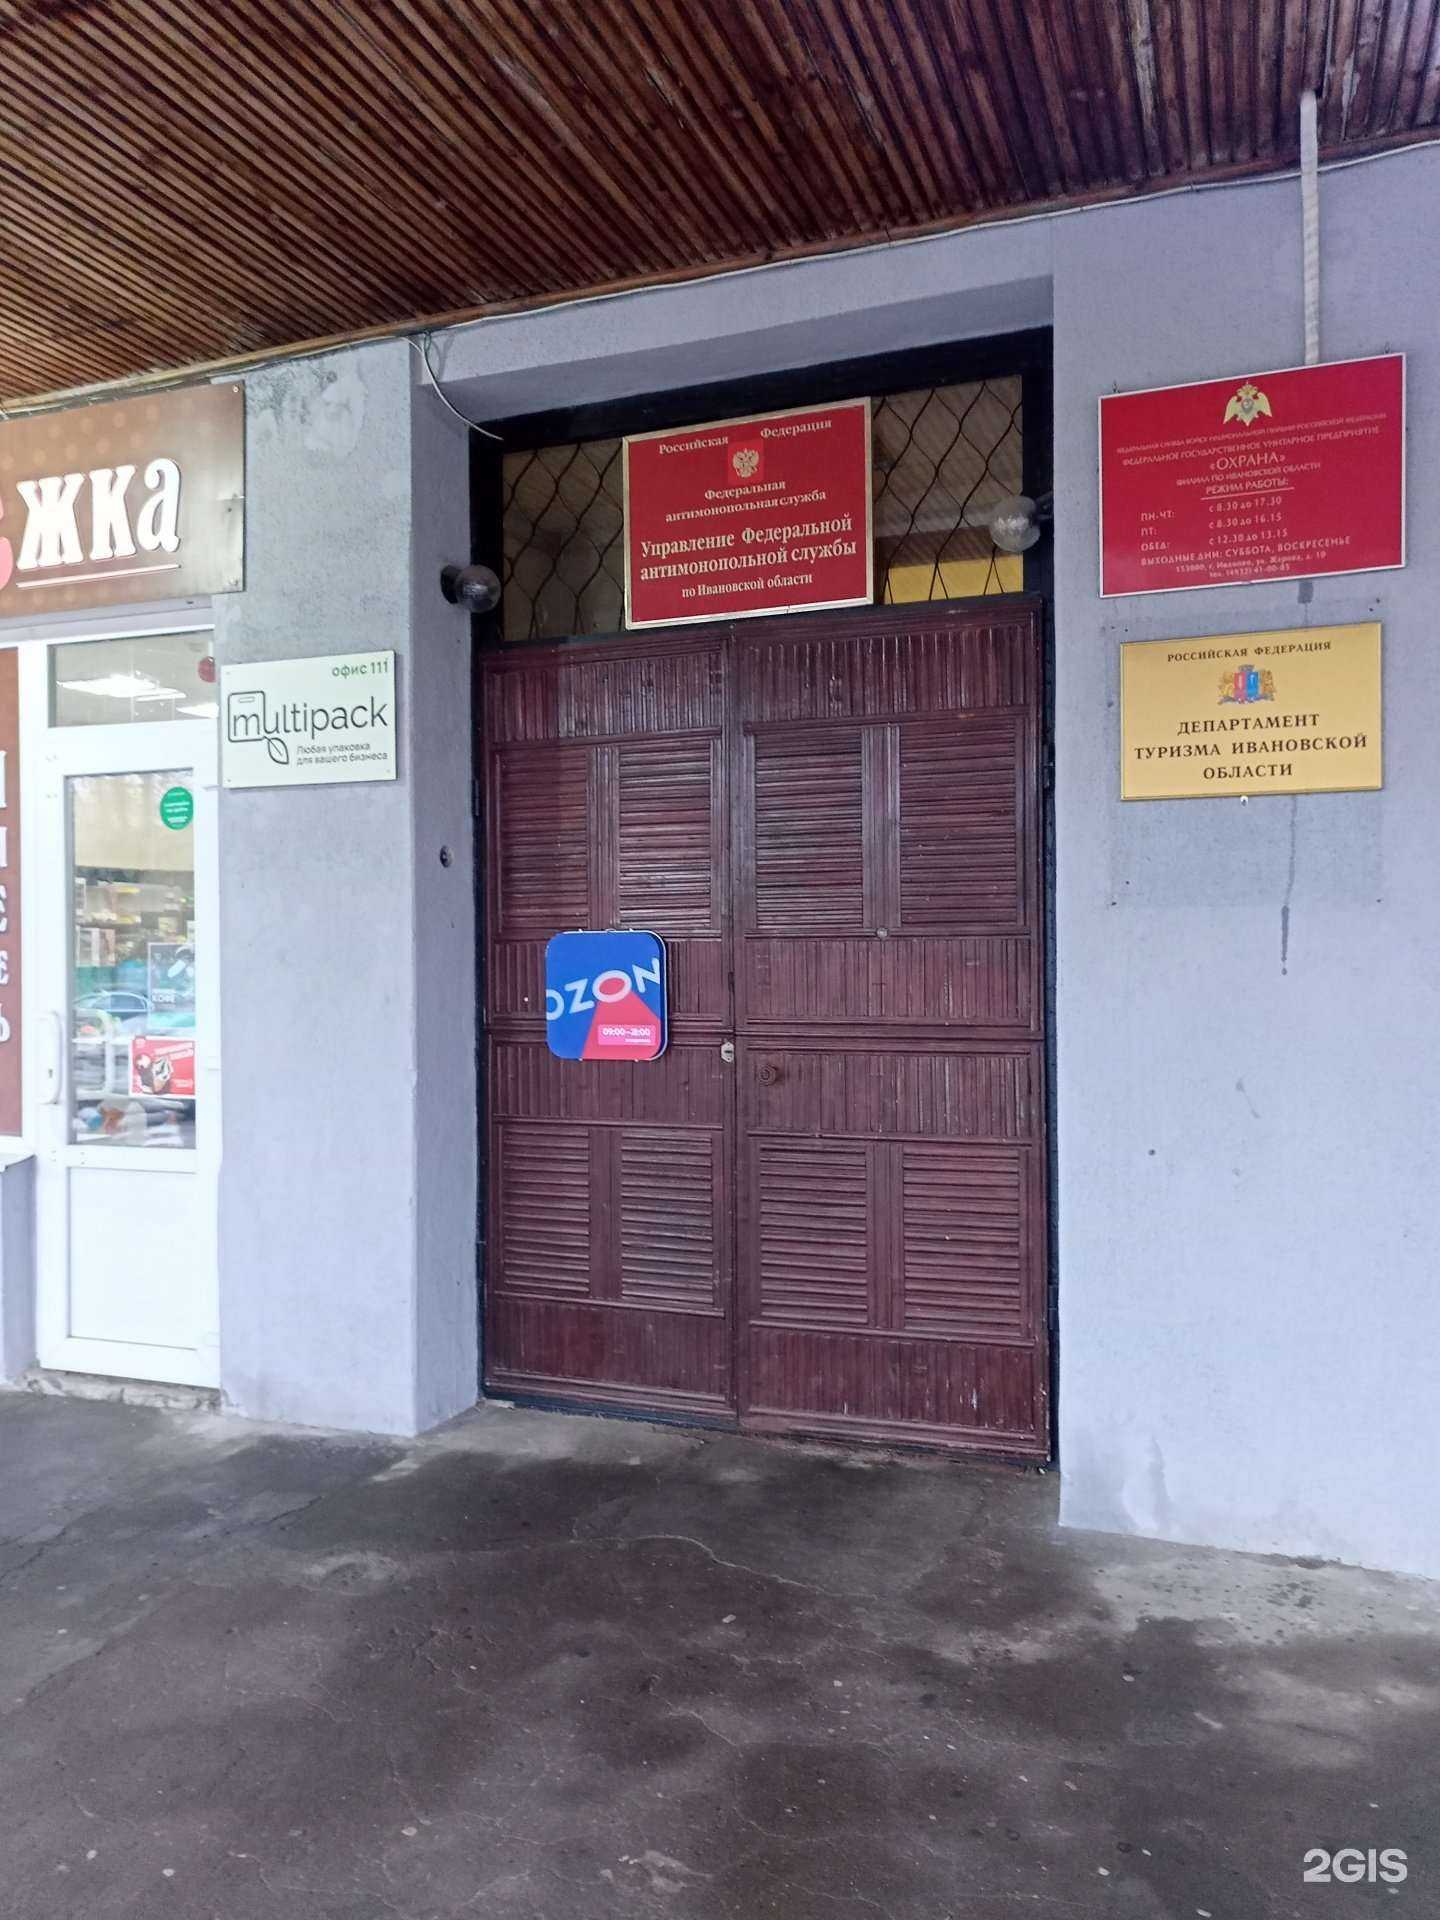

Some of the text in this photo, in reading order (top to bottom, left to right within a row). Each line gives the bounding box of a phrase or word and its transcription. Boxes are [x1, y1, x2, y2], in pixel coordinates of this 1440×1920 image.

[658, 419, 832, 456] Российская Федерация
[1122, 426, 1379, 466] ФЕДЕРАЛЬНОЕ ГОСУДАРСТВЕННОЕ УНИТАРНОЕ ПРЕДПРИЯТИЕ
[1210, 452, 1285, 470] «ОХРАНА»
[1211, 473, 1224, 482] ПО
[1283, 462, 1320, 474] ОБЛАСТИ
[704, 481, 786, 501] Федеральная
[1206, 478, 1288, 495] РЕЖИМ РАБОТЫ:
[665, 489, 826, 523] антимонопольная служба
[1216, 501, 1238, 512] 8.30
[1255, 496, 1282, 507] 17.30
[1240, 518, 1252, 526] до
[1255, 512, 1282, 524] 16.15
[640, 513, 852, 560] Управление Федеральной
[1217, 534, 1244, 544] 12.30
[1261, 528, 1288, 539] 13.15
[640, 538, 857, 581] антимонопольной службы
[1141, 552, 1196, 566] ВЫХОДНЫЕ
[1198, 550, 1222, 561] ДНИ:
[1277, 535, 1351, 552] ВОСКРЕСЕНЬЕ
[682, 572, 812, 599] по Ивановской области
[1167, 641, 1332, 662] РОССИЙСКАЯ ФЕДЕРАЦИЯ
[332, 660, 388, 679] офис 111
[231, 695, 388, 740] multipack
[1177, 713, 1320, 736] ДЕПАРТАМЕНТ
[328, 743, 370, 754] упаковка
[349, 752, 388, 762] бизнеса
[1134, 735, 1368, 760] ТУРИЗМА ИВАНОВСКОЙ
[1203, 763, 1293, 780] ОБЛАСТИ
